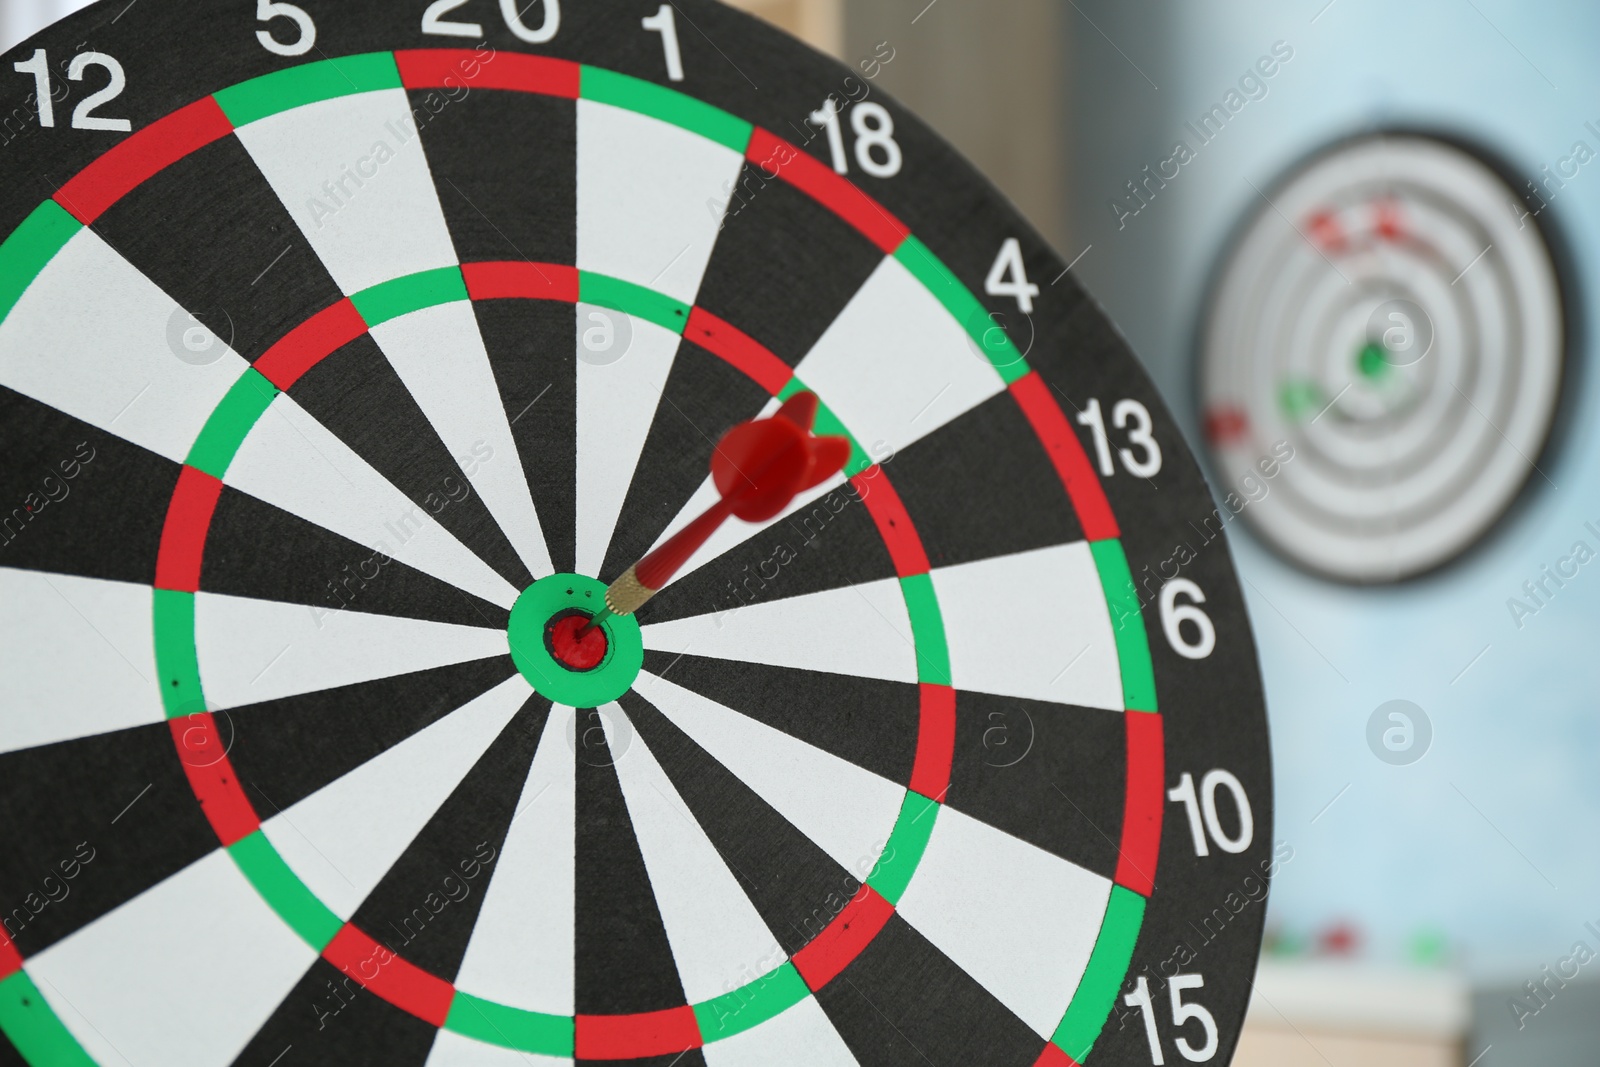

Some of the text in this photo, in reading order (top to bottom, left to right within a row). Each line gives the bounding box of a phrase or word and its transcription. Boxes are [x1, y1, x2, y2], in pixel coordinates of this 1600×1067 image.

[255, 0, 317, 56] 5
[641, 4, 684, 81] 1
[14, 48, 132, 132] 12
[810, 98, 902, 178] 18
[984, 237, 1040, 314] 4
[1076, 398, 1163, 479] 13
[1159, 577, 1216, 659] 6
[1167, 768, 1254, 857] 10
[1124, 974, 1219, 1066] 15
